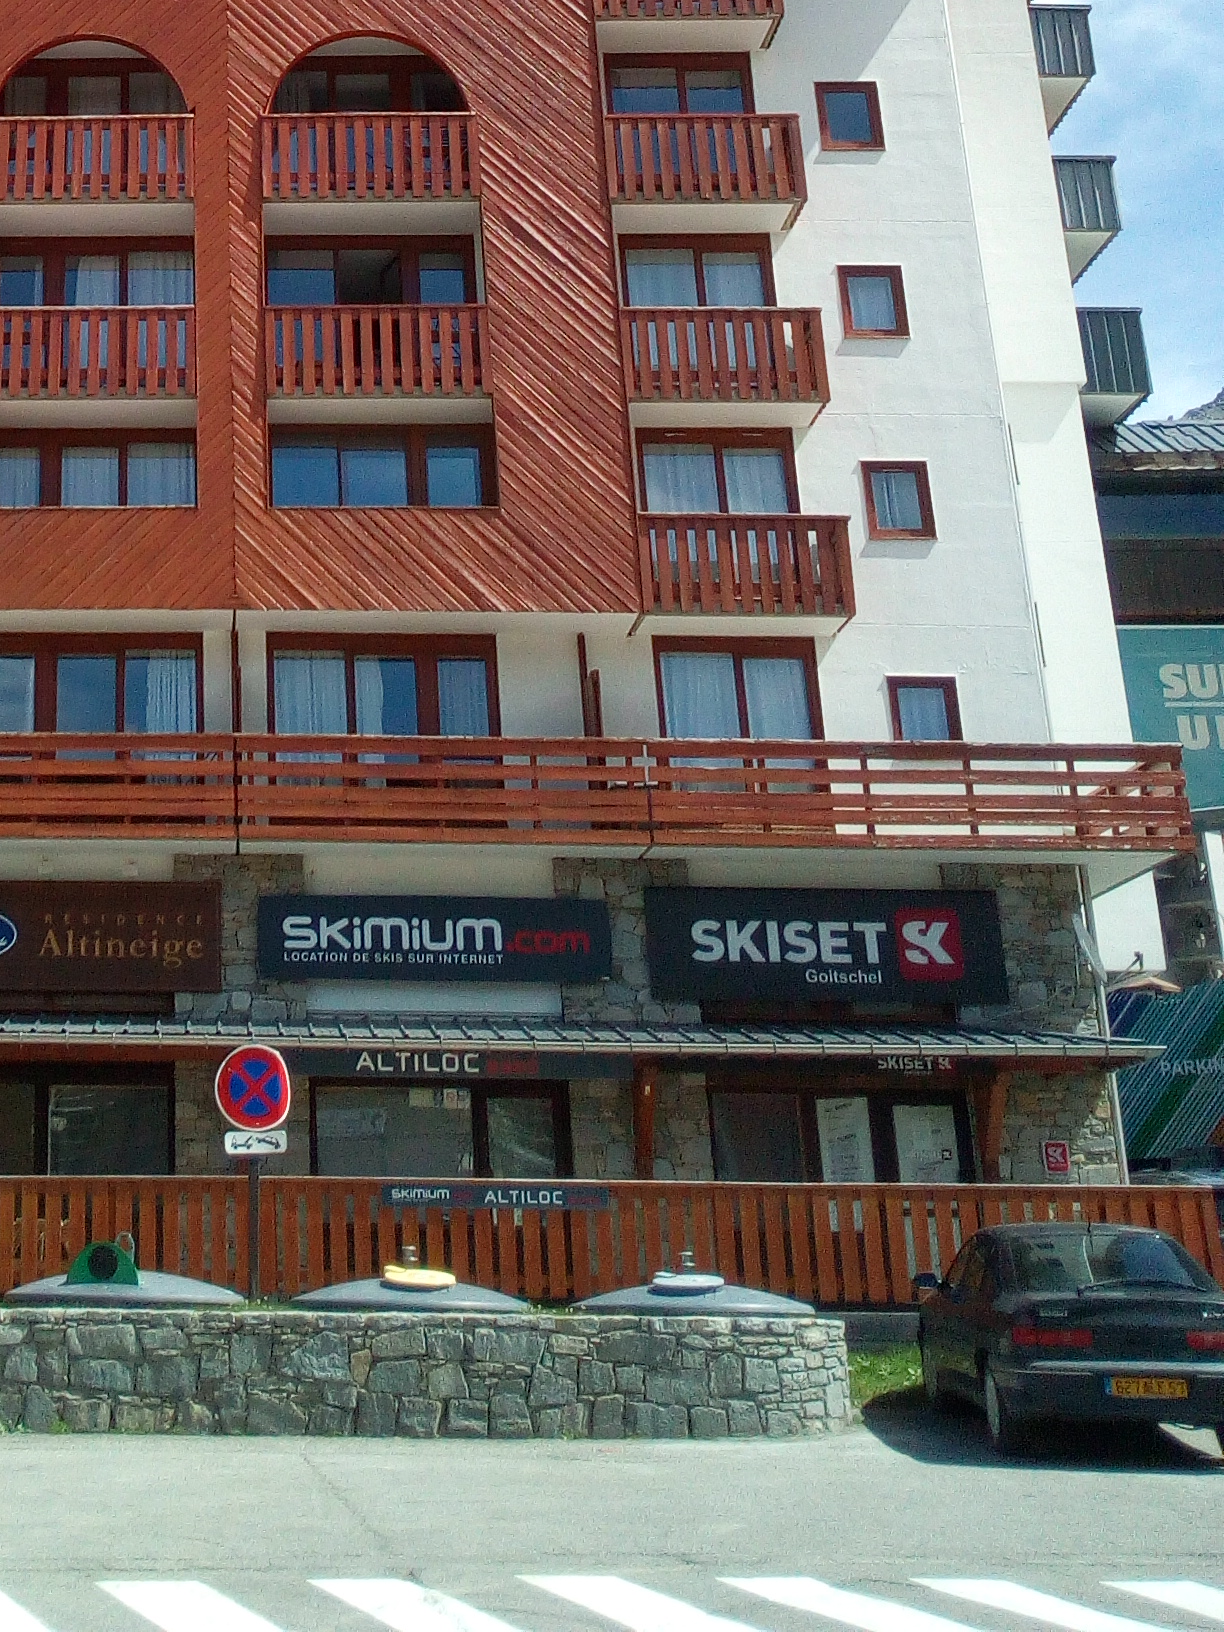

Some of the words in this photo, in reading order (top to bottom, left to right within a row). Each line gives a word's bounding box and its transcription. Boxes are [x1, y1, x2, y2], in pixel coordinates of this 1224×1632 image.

[39, 928, 204, 969] Altineige
[690, 919, 887, 964] SKISET
[352, 952, 370, 963] DE
[408, 953, 434, 964] SUR
[356, 1052, 480, 1073] ALTILOC
[877, 1055, 934, 1070] SKISET
[484, 1190, 563, 1204] ALTILOC
